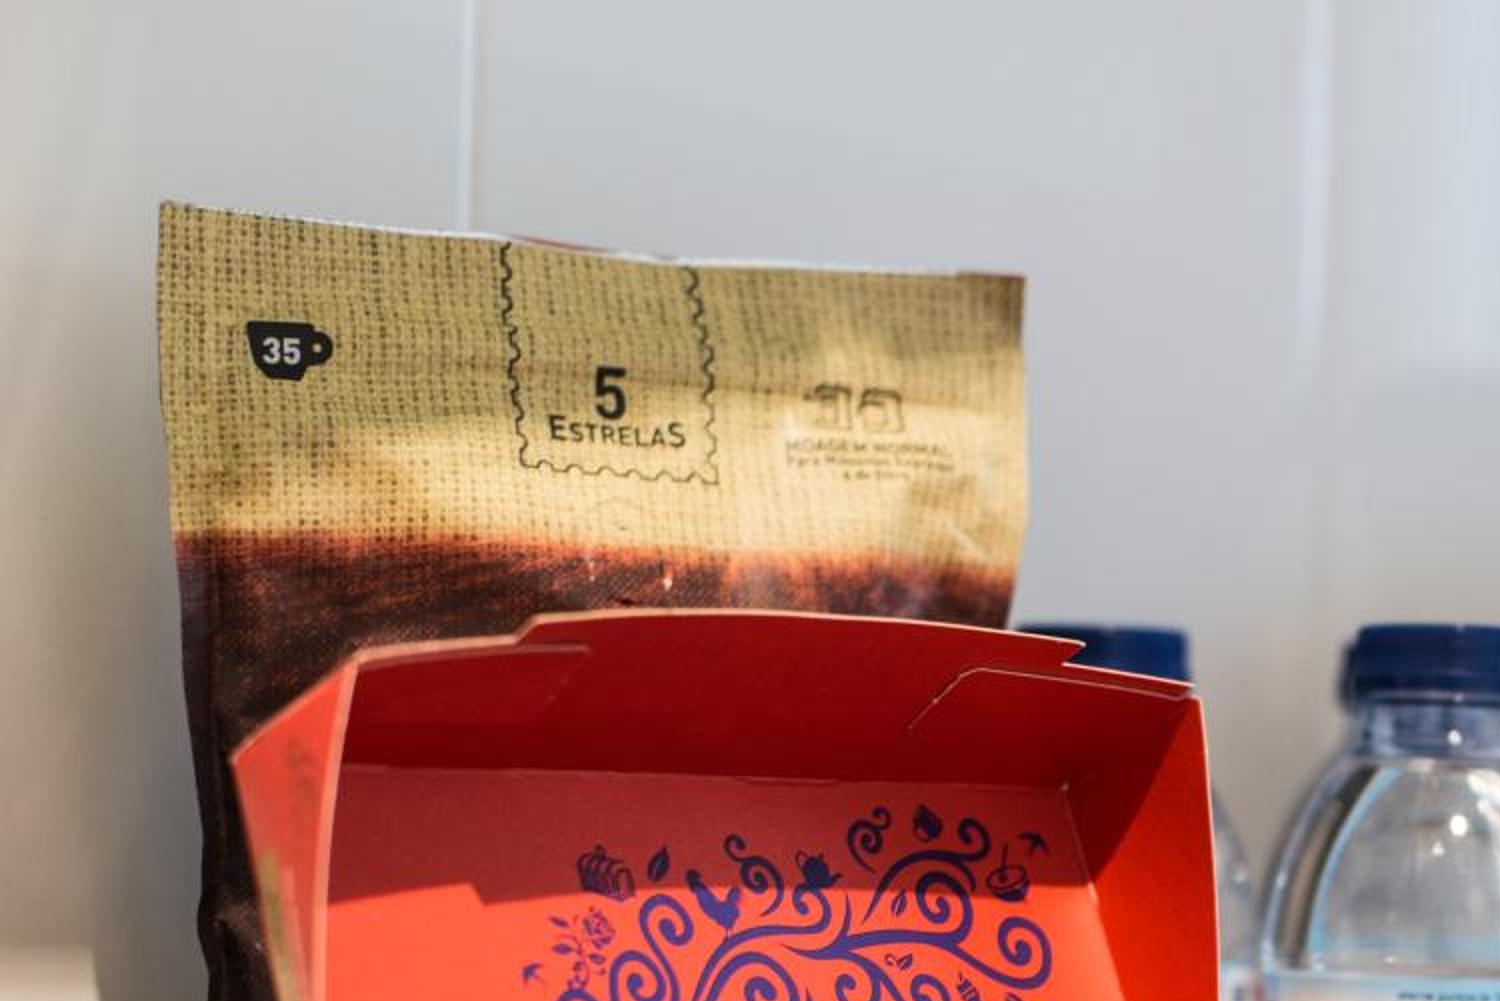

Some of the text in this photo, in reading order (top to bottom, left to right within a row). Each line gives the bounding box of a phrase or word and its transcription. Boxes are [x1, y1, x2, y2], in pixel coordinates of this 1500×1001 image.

[262, 337, 301, 365] 35
[595, 366, 627, 419] 5
[548, 414, 686, 448] ESTRELAS
